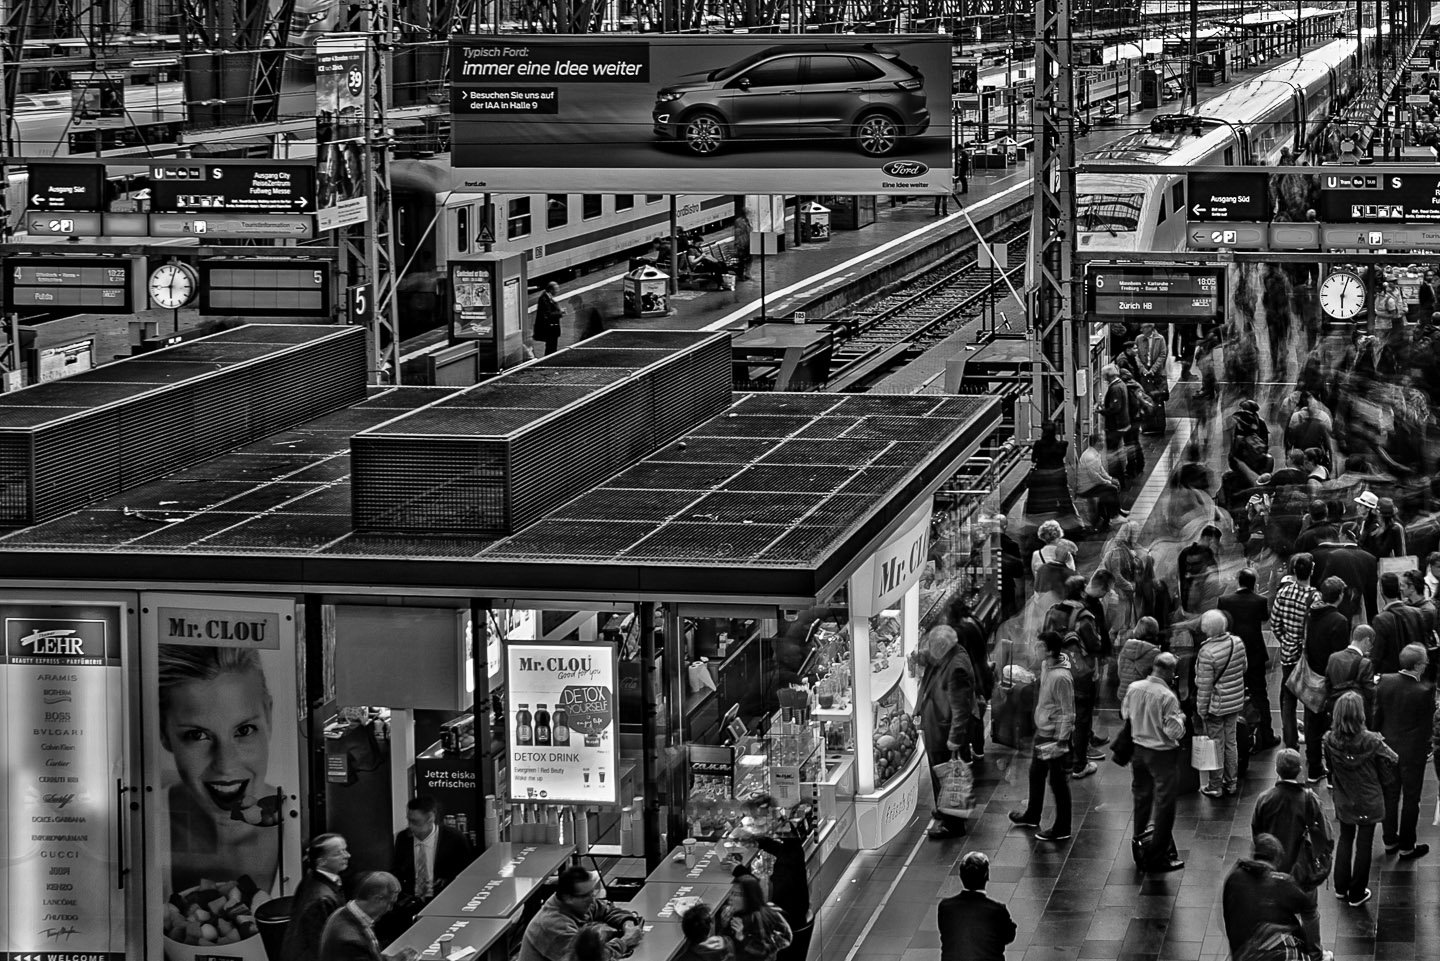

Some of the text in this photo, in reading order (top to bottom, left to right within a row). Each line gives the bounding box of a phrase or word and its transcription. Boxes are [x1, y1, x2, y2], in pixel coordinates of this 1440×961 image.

[462, 47, 529, 58] Typisch Ford:
[462, 60, 642, 75] immer eine Idee weiter
[349, 71, 362, 87] 39
[1429, 78, 1437, 88] A
[470, 91, 509, 99] Besuchen
[510, 91, 523, 99] Sie
[541, 91, 554, 99] auf
[154, 168, 223, 179] U S
[891, 162, 920, 175] Ford
[254, 172, 291, 180] Ausgang City
[1327, 177, 1402, 188] U S
[1210, 196, 1237, 204] Ausgang
[14, 266, 22, 280] 4
[314, 270, 322, 283] 5
[1096, 274, 1104, 288] 6
[1197, 278, 1216, 286] 18:05
[35, 292, 53, 300] Fulda
[356, 287, 365, 314] 5
[1119, 302, 1152, 310] Zürich HB
[879, 556, 906, 598] Mr.
[168, 618, 265, 642] Mr. CLOU
[32, 629, 84, 655] LEHR
[520, 658, 592, 672] Mr. CLOU
[37, 674, 78, 682] ARAMIS
[558, 671, 576, 679] Good
[564, 686, 606, 704] DETOX
[568, 701, 608, 714] YOURSELF
[45, 712, 72, 720] BOSS
[41, 743, 60, 751] Calvin
[514, 752, 580, 762] DETOX DRINK
[45, 759, 71, 767] Cartier
[424, 770, 449, 779] Jetzt
[428, 779, 476, 789] erfrischen
[46, 883, 73, 891] KENZO
[42, 898, 77, 906] LANCÔME
